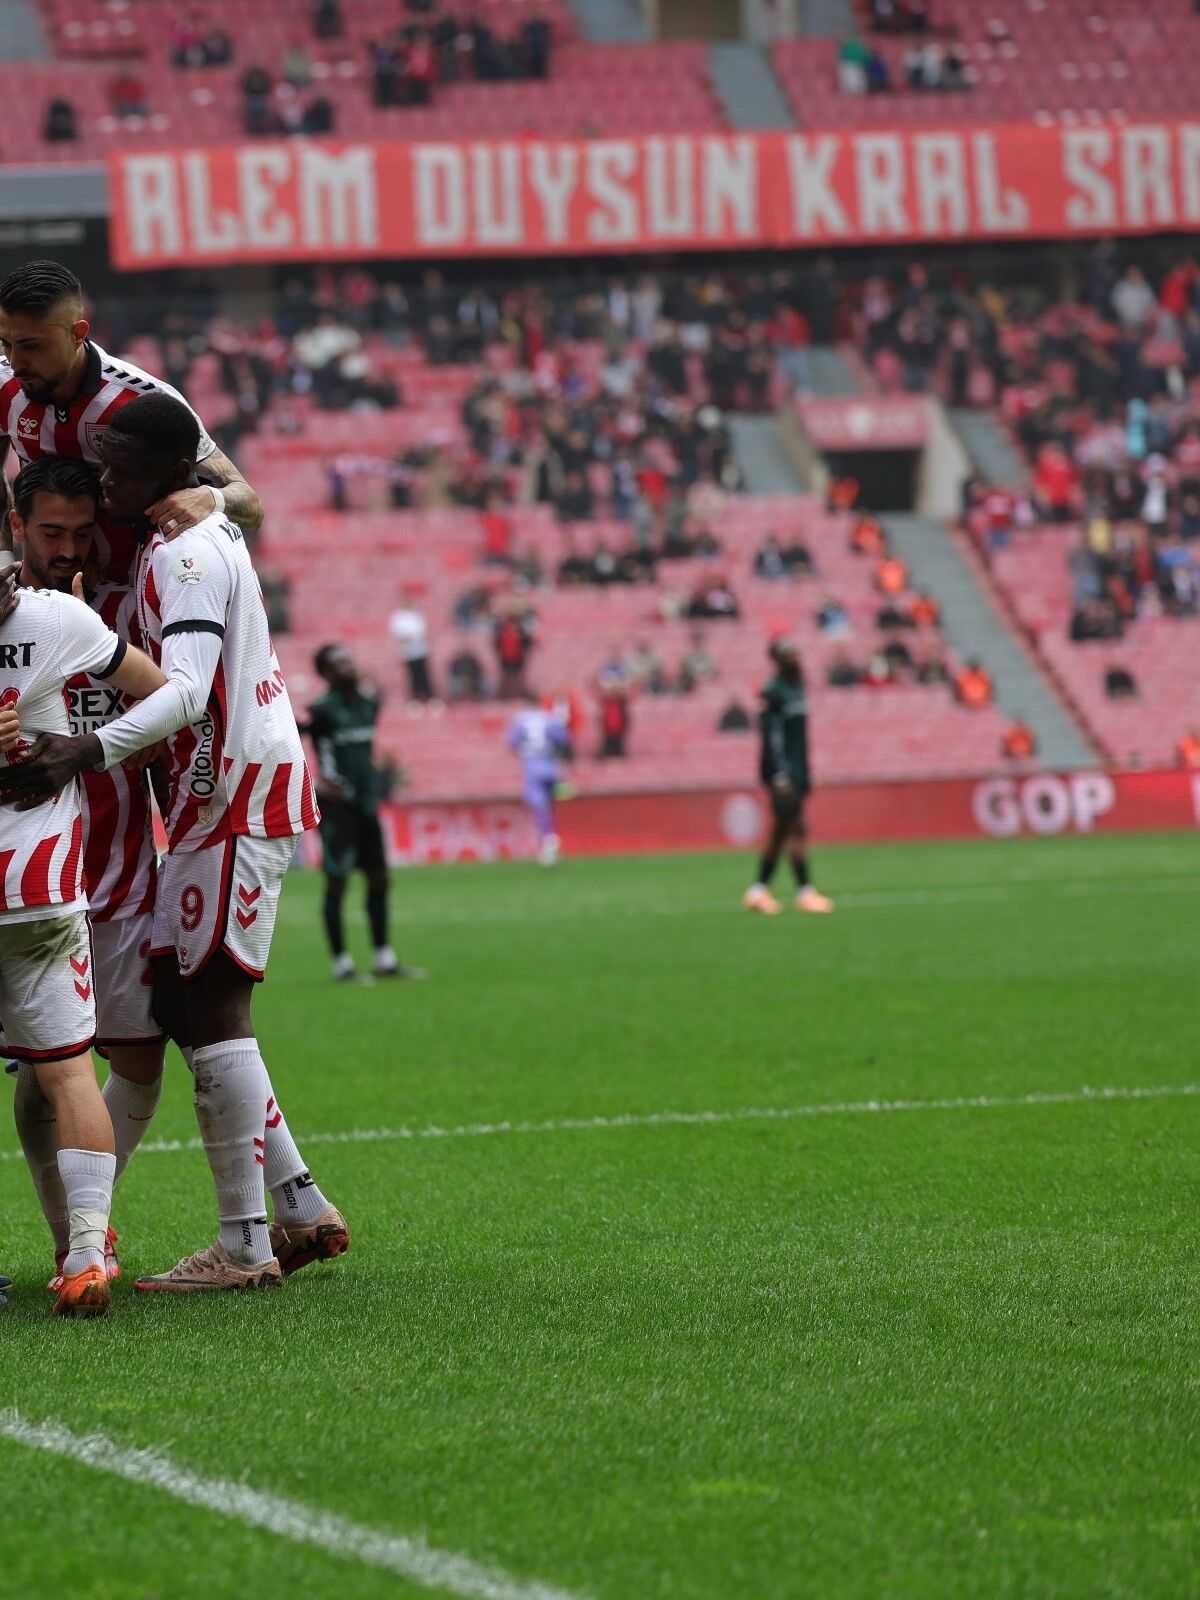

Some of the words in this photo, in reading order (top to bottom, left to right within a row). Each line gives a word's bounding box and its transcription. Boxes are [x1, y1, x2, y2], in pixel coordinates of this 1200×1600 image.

[121, 146, 379, 258] ALEM
[412, 133, 759, 246] DUYSUN
[787, 126, 1030, 236] KRAL
[971, 771, 1116, 838] GOP
[181, 884, 205, 933] 9
